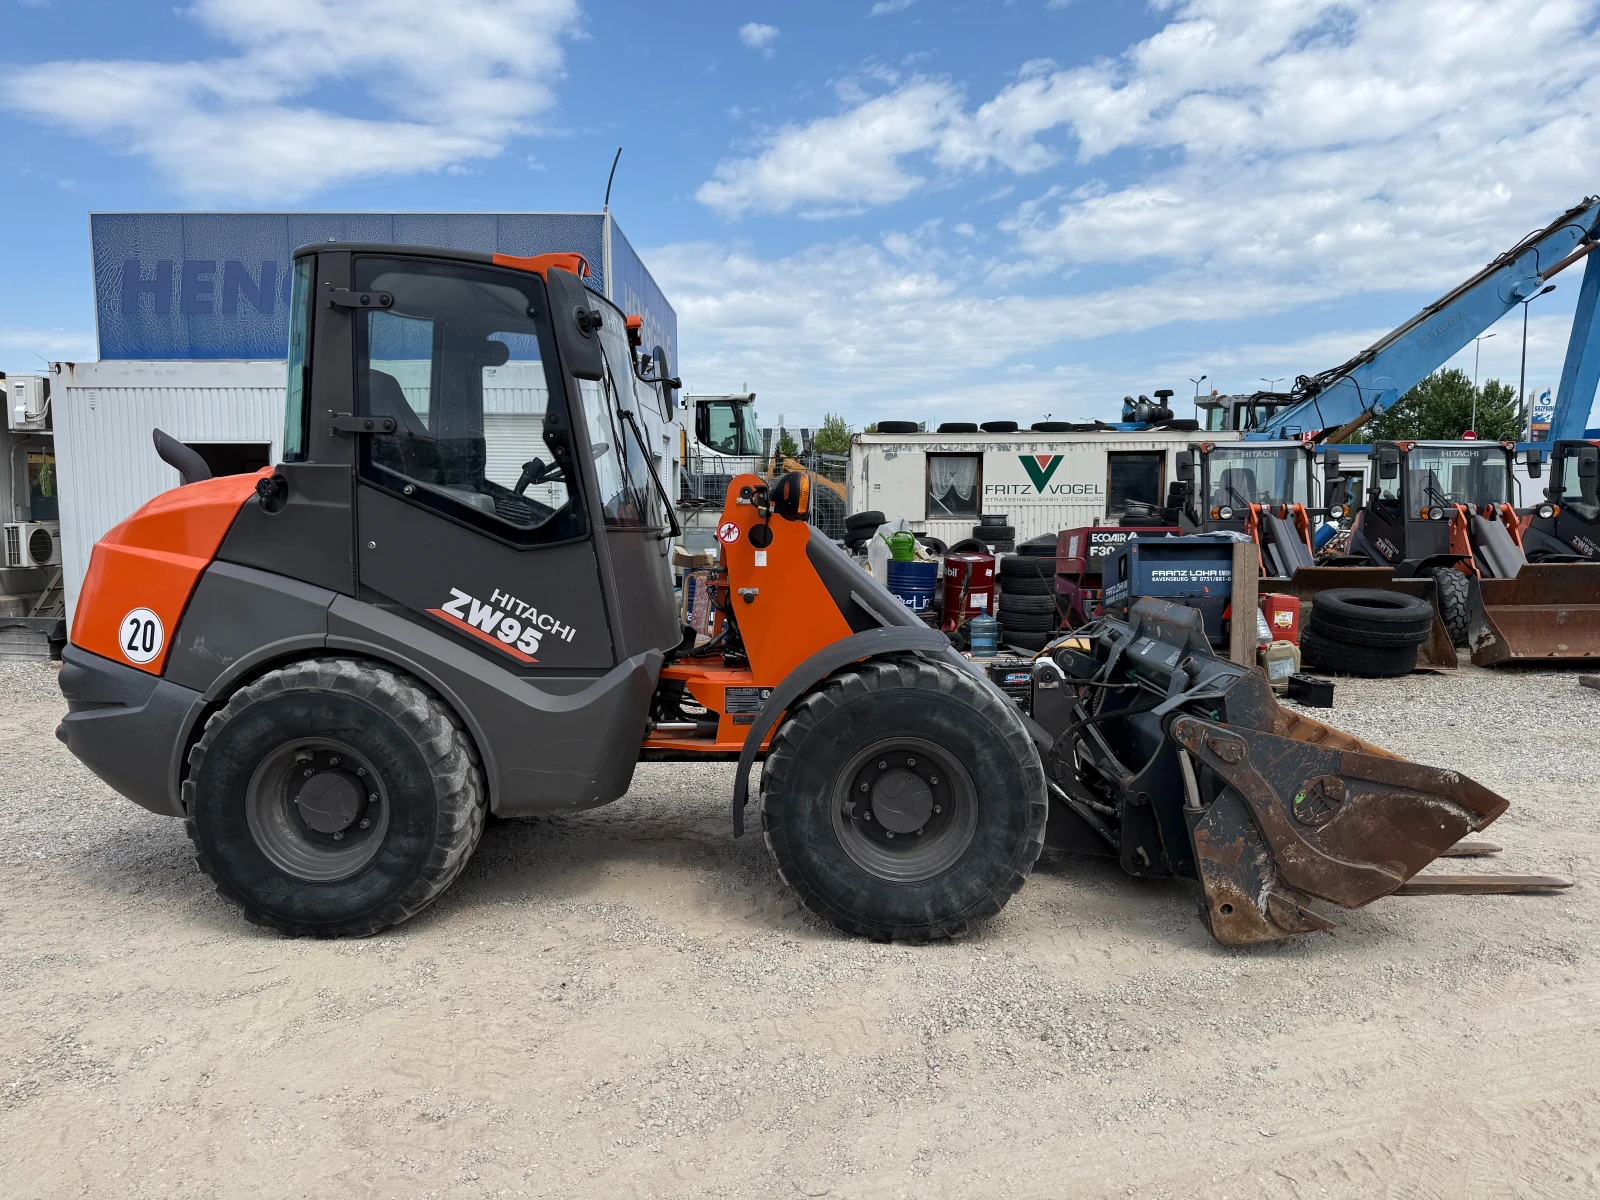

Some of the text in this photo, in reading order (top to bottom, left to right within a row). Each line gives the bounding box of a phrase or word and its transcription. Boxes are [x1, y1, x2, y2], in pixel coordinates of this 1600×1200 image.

[121, 259, 292, 315] HEN
[1431, 307, 1468, 336] TEREX
[1241, 450, 1279, 458] HITACHI
[1441, 450, 1479, 458] HITACHI
[985, 484, 1104, 495] FRITZ VOGEL
[1091, 533, 1127, 543] ECOAIR
[1572, 535, 1594, 556] ZW95
[441, 587, 544, 655] ZW95
[490, 588, 577, 643] HITACHI
[127, 618, 155, 653] 20
